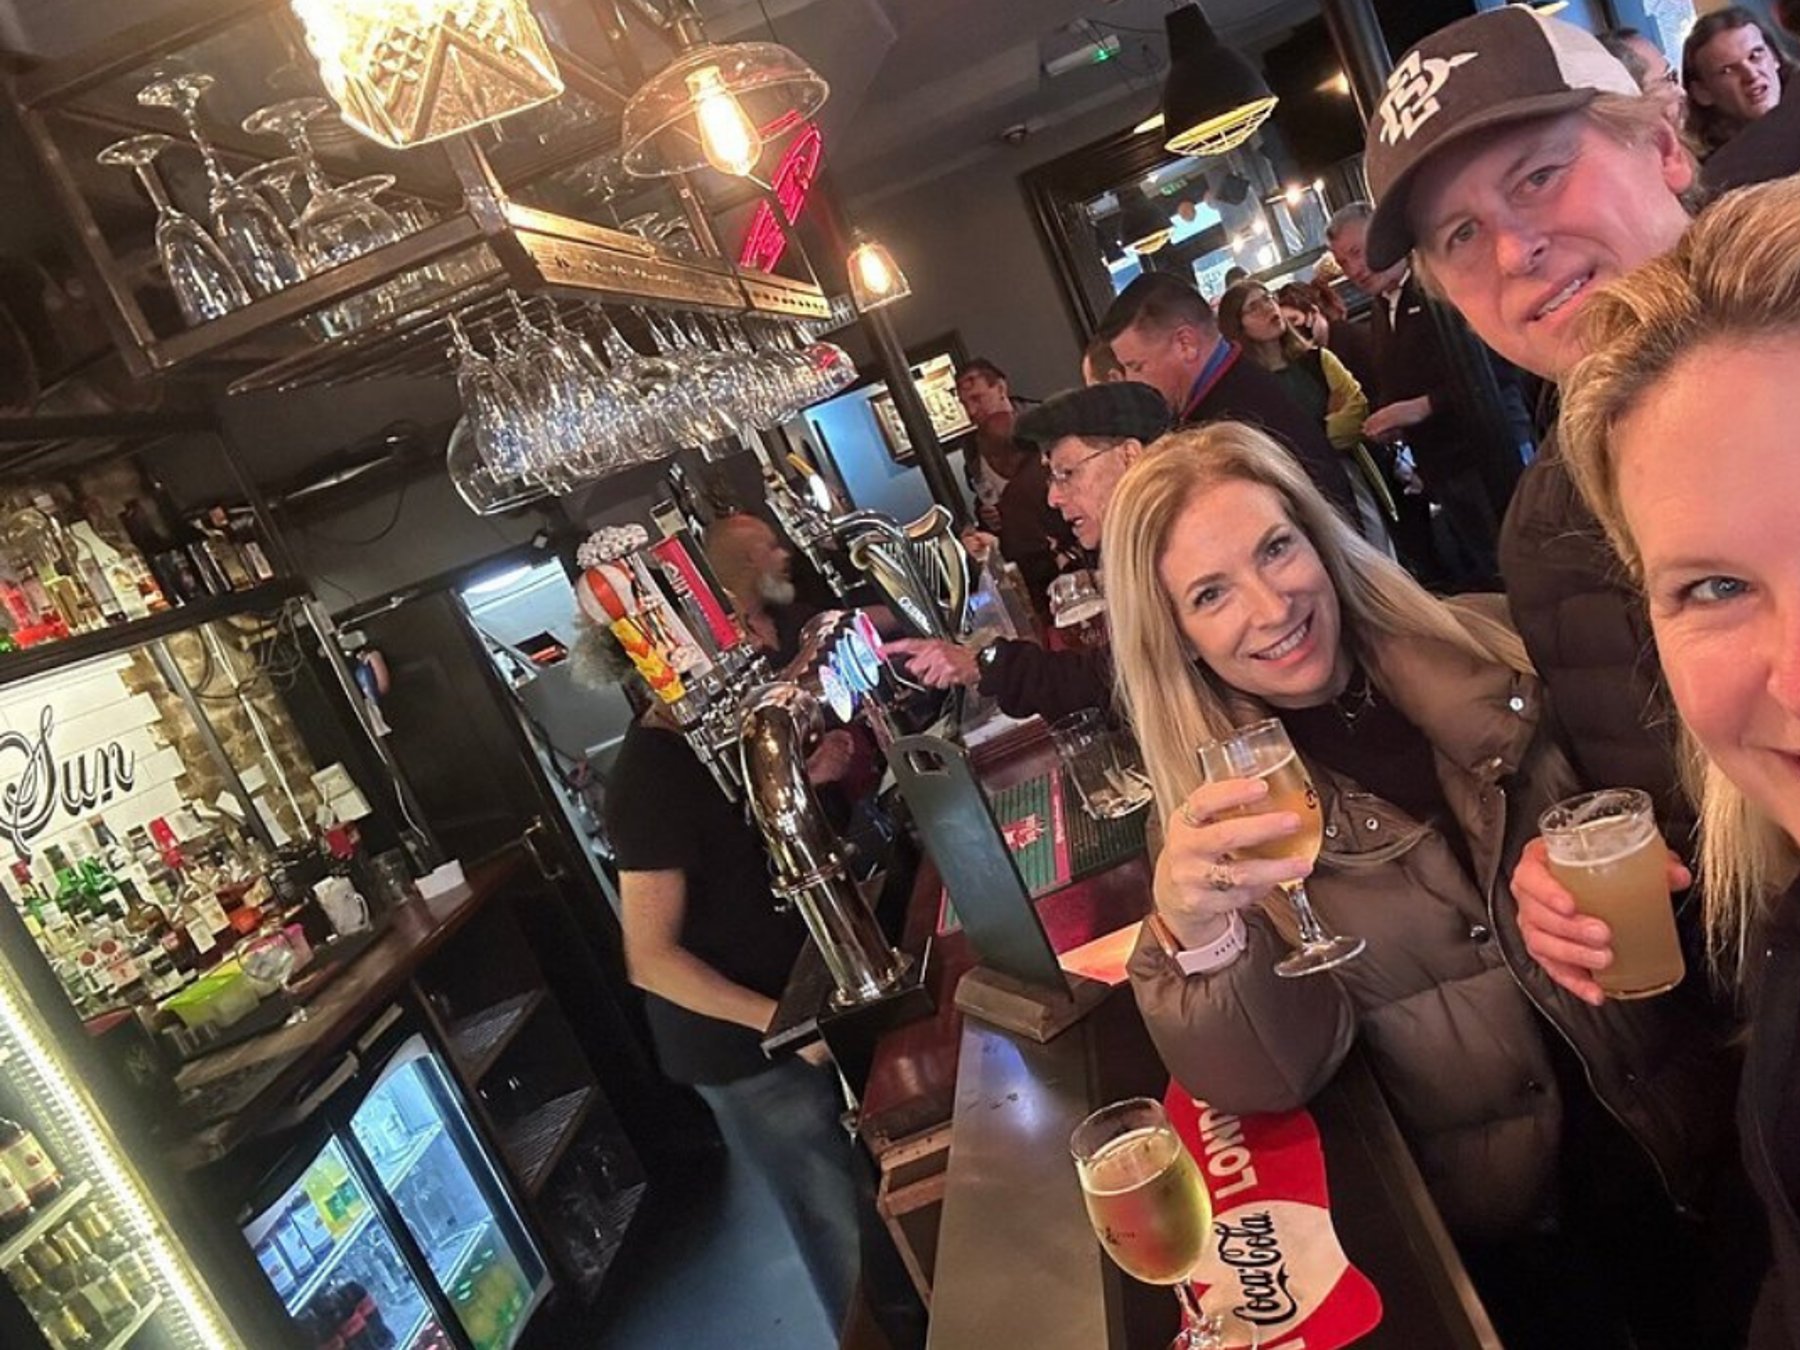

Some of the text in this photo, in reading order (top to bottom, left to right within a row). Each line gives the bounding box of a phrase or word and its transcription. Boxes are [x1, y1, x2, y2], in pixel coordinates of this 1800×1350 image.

[0, 705, 135, 864] Sun
[1193, 1098, 1258, 1199] LOND
[1213, 1210, 1297, 1325] Coca-Cola
